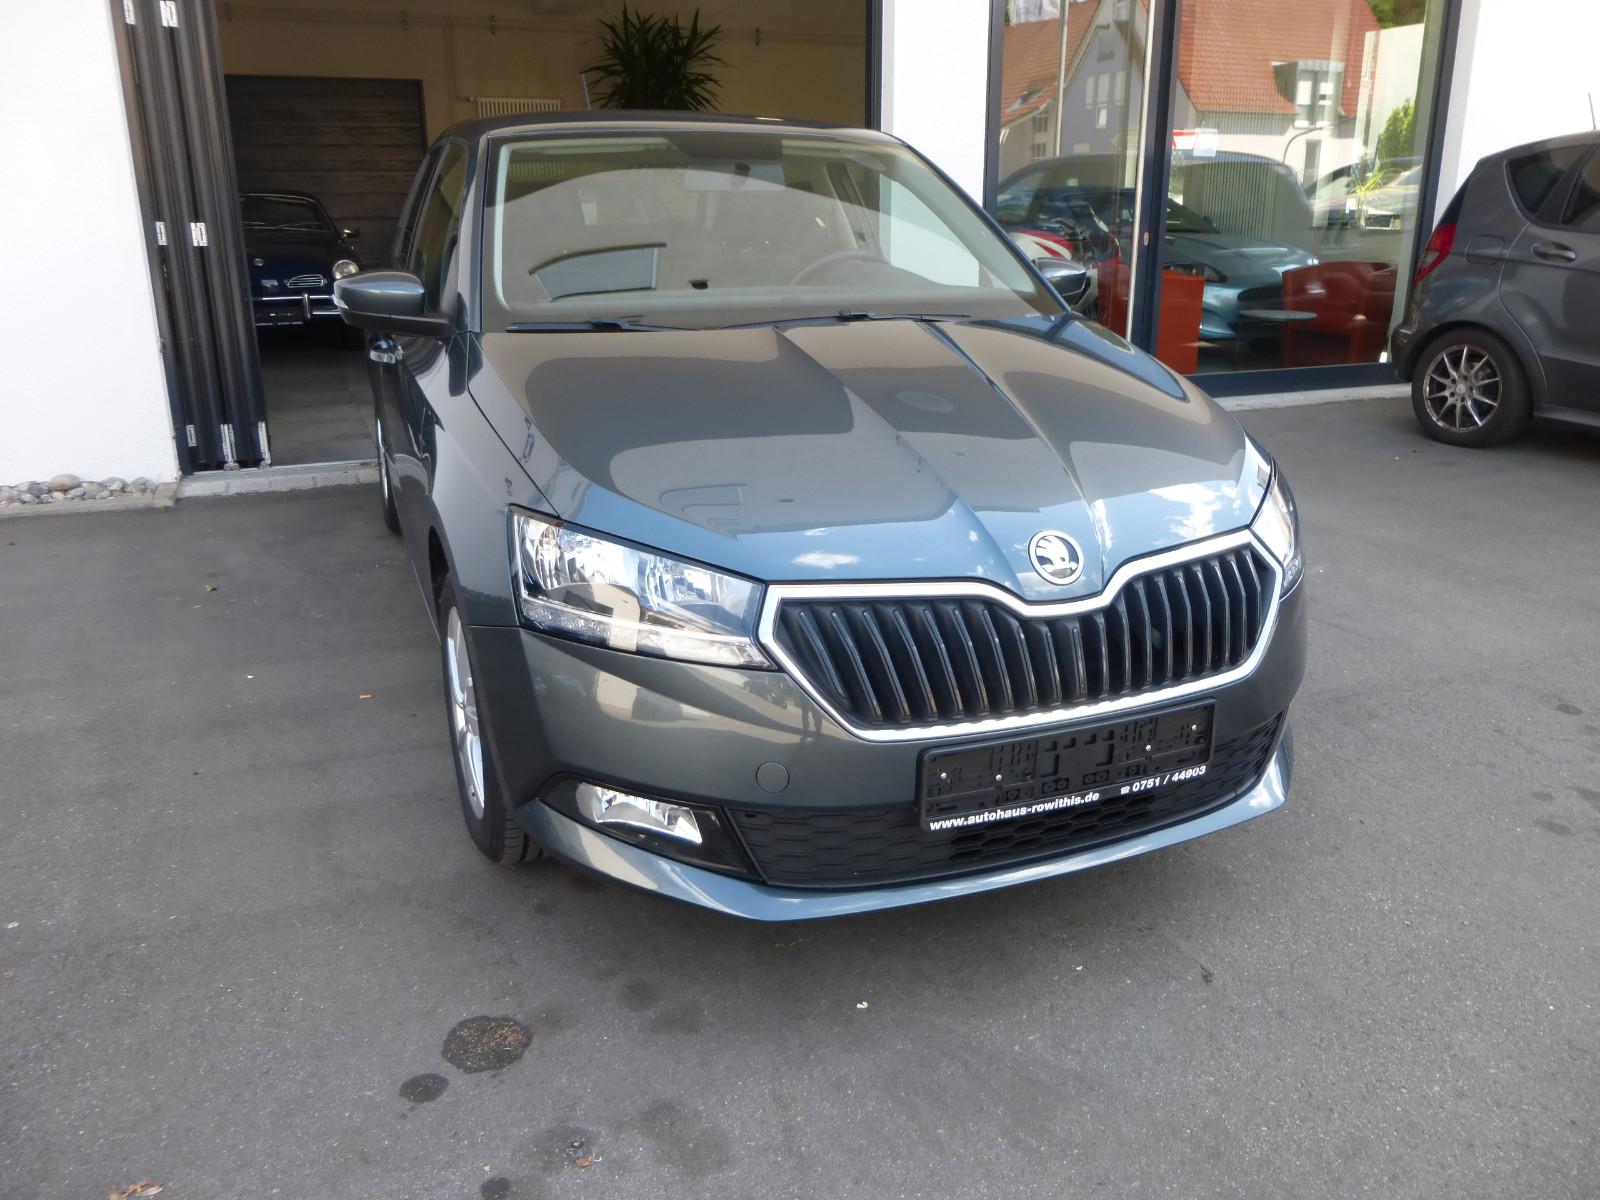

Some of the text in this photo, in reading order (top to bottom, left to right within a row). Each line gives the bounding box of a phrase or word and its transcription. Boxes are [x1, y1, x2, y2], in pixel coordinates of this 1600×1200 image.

[929, 792, 1100, 831] www.autohaus-rowithis.de
[1132, 777, 1160, 792] 0751
[1171, 765, 1206, 782] 44903
